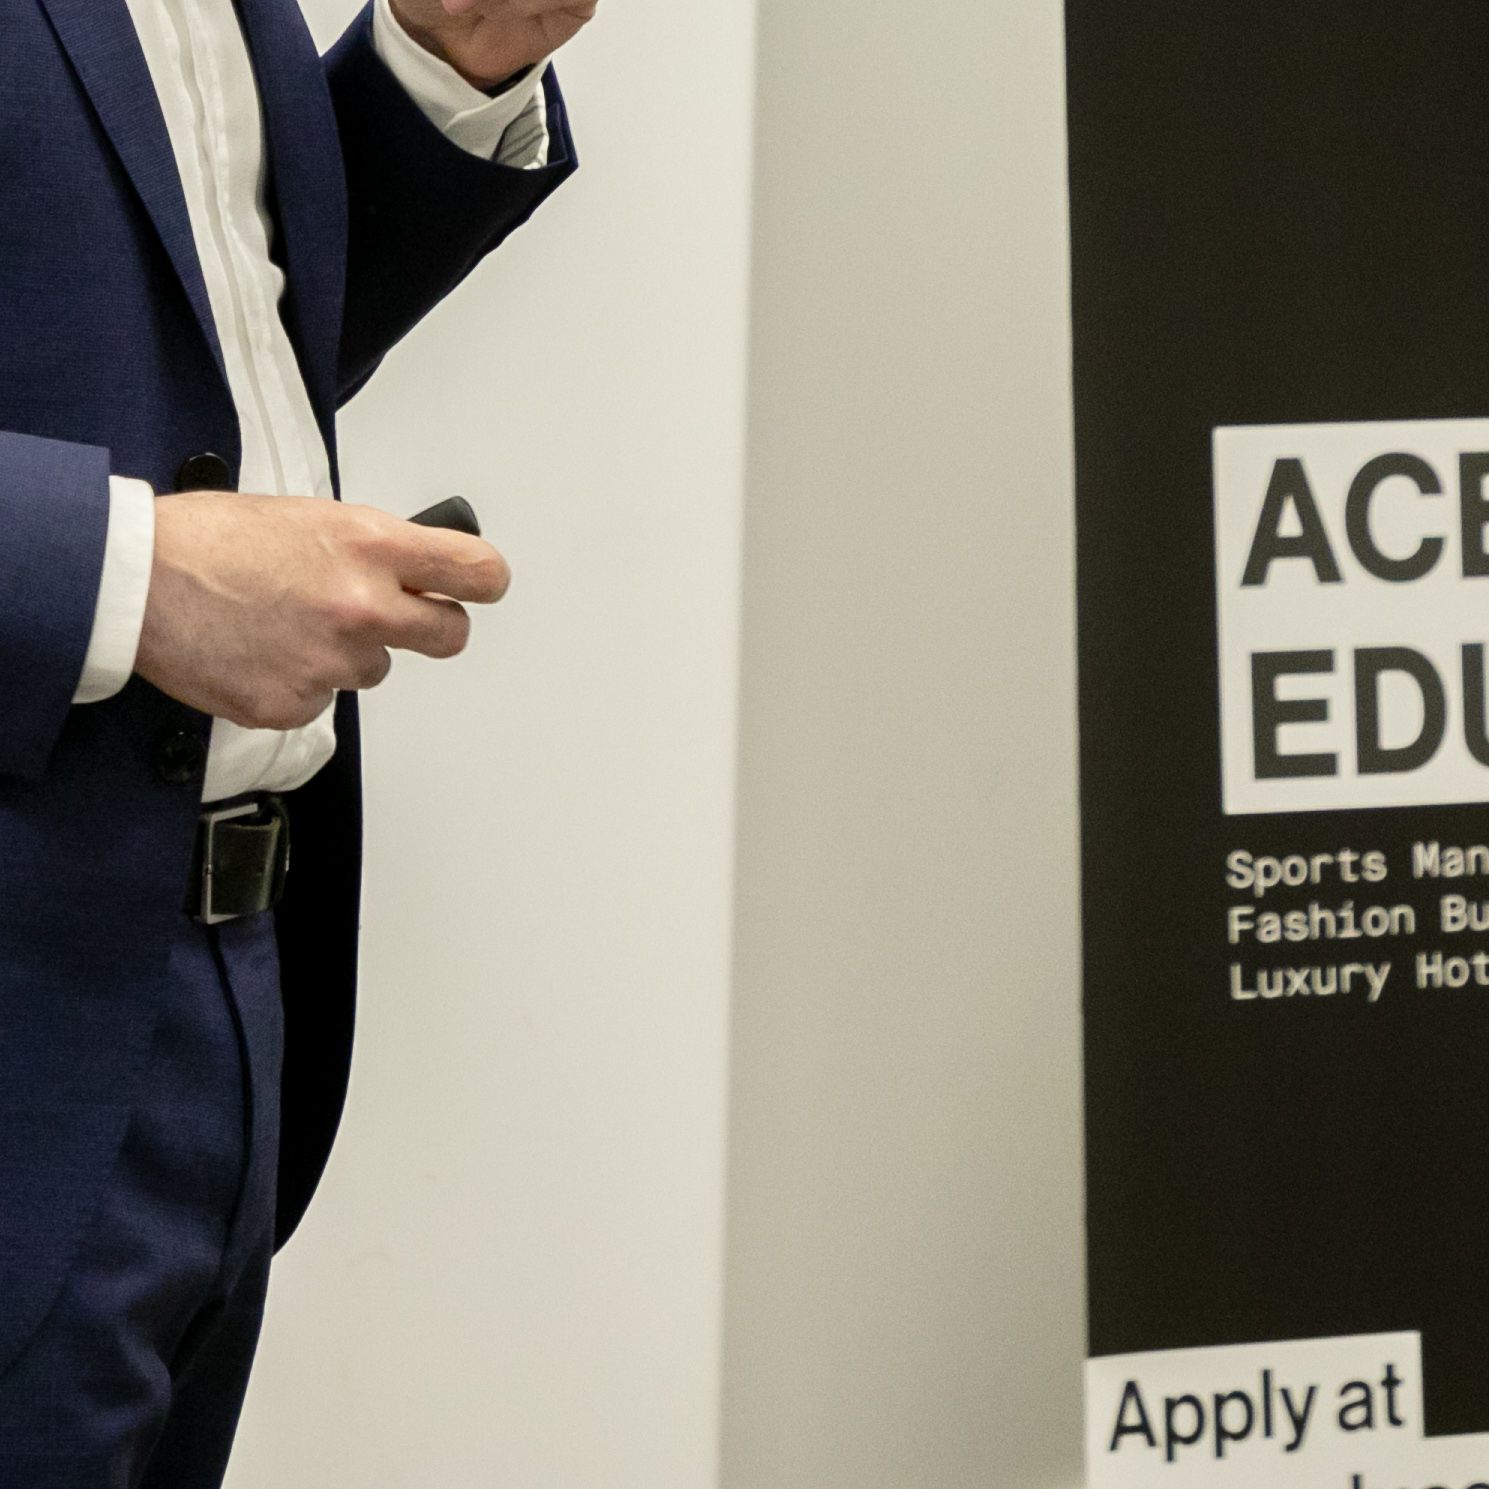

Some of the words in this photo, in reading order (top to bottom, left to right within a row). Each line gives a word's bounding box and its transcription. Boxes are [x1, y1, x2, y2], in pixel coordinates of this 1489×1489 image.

[1226, 848, 1387, 896] Sports
[1228, 901, 1415, 943] Fashion
[1231, 962, 1391, 1002] Luxury
[1109, 1369, 1318, 1463] Apply
[1338, 1364, 1404, 1432] at
